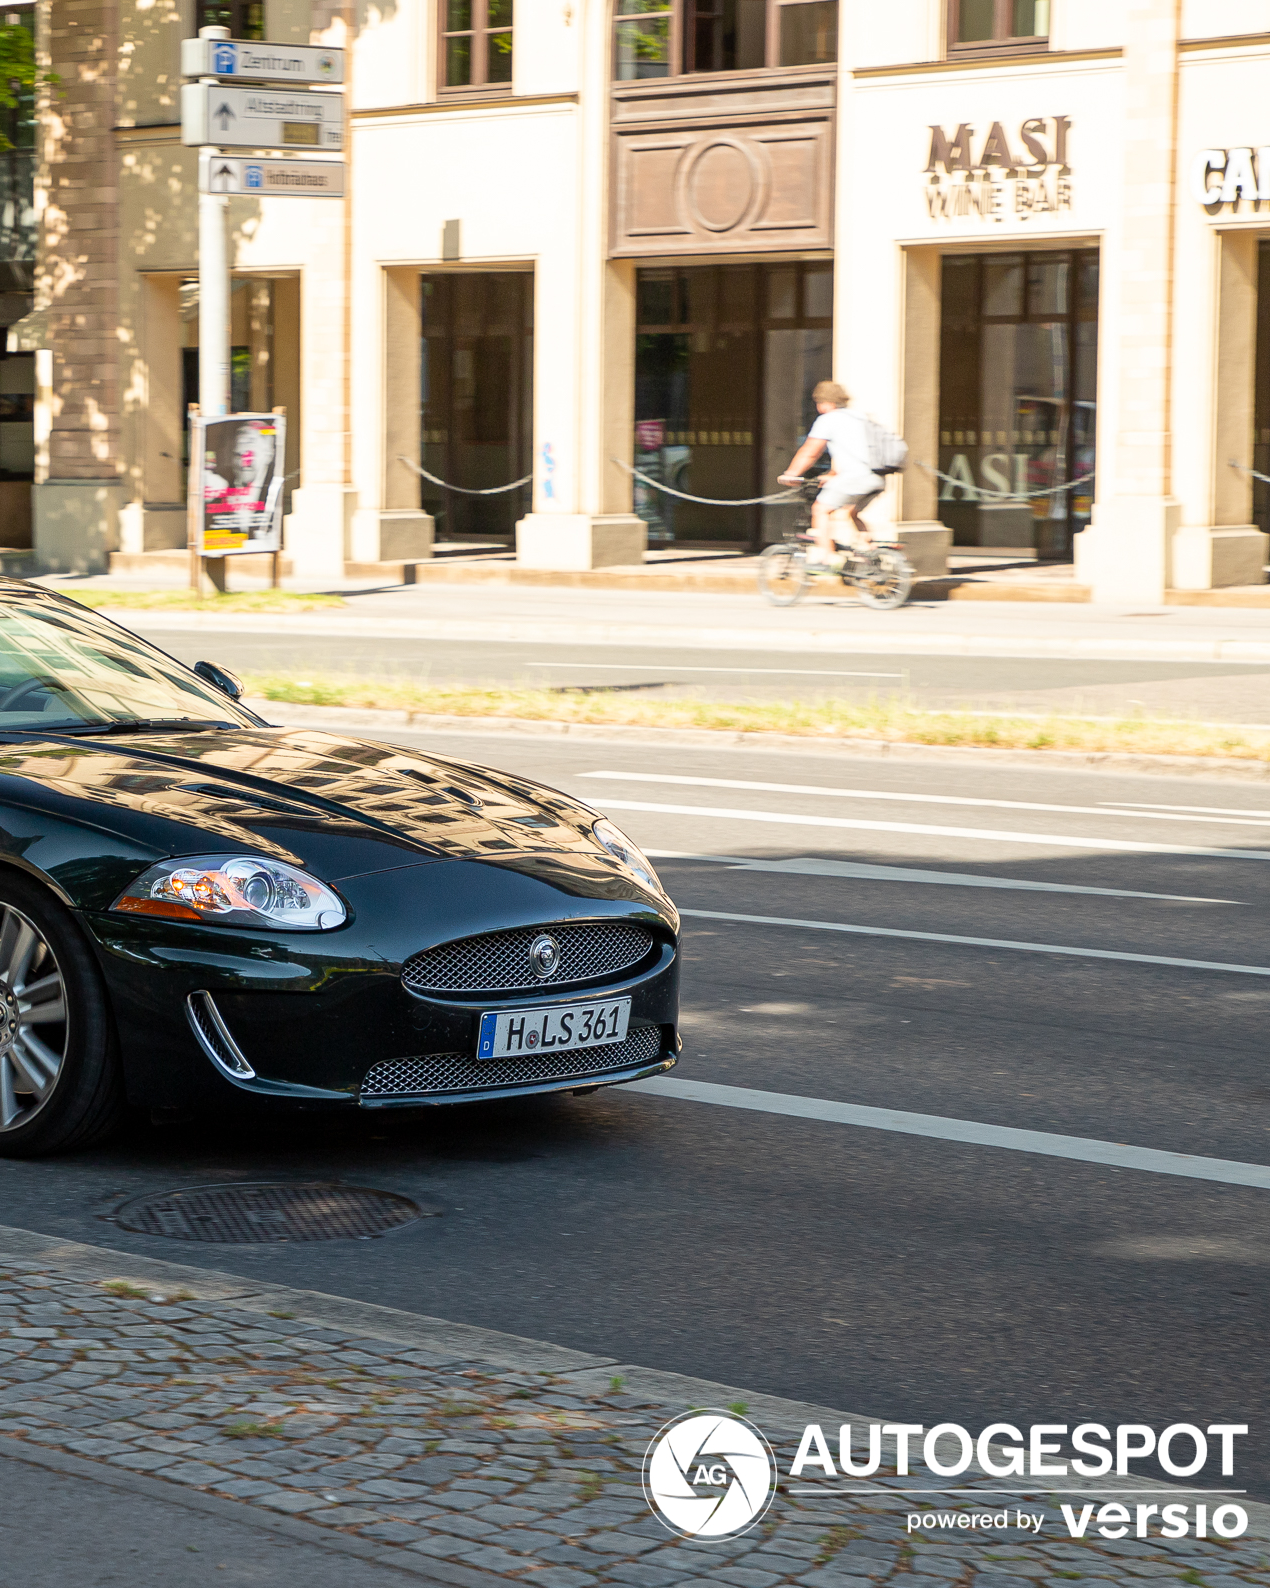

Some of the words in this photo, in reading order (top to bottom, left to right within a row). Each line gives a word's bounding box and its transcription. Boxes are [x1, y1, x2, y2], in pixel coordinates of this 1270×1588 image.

[241, 51, 305, 72] Zentrum
[922, 115, 1071, 177] MASI
[924, 181, 1003, 220] WINE
[1015, 177, 1071, 219] BAR
[483, 1040, 491, 1051] D
[506, 1016, 526, 1051] H
[541, 1012, 574, 1047] LS
[578, 1005, 620, 1042] 361
